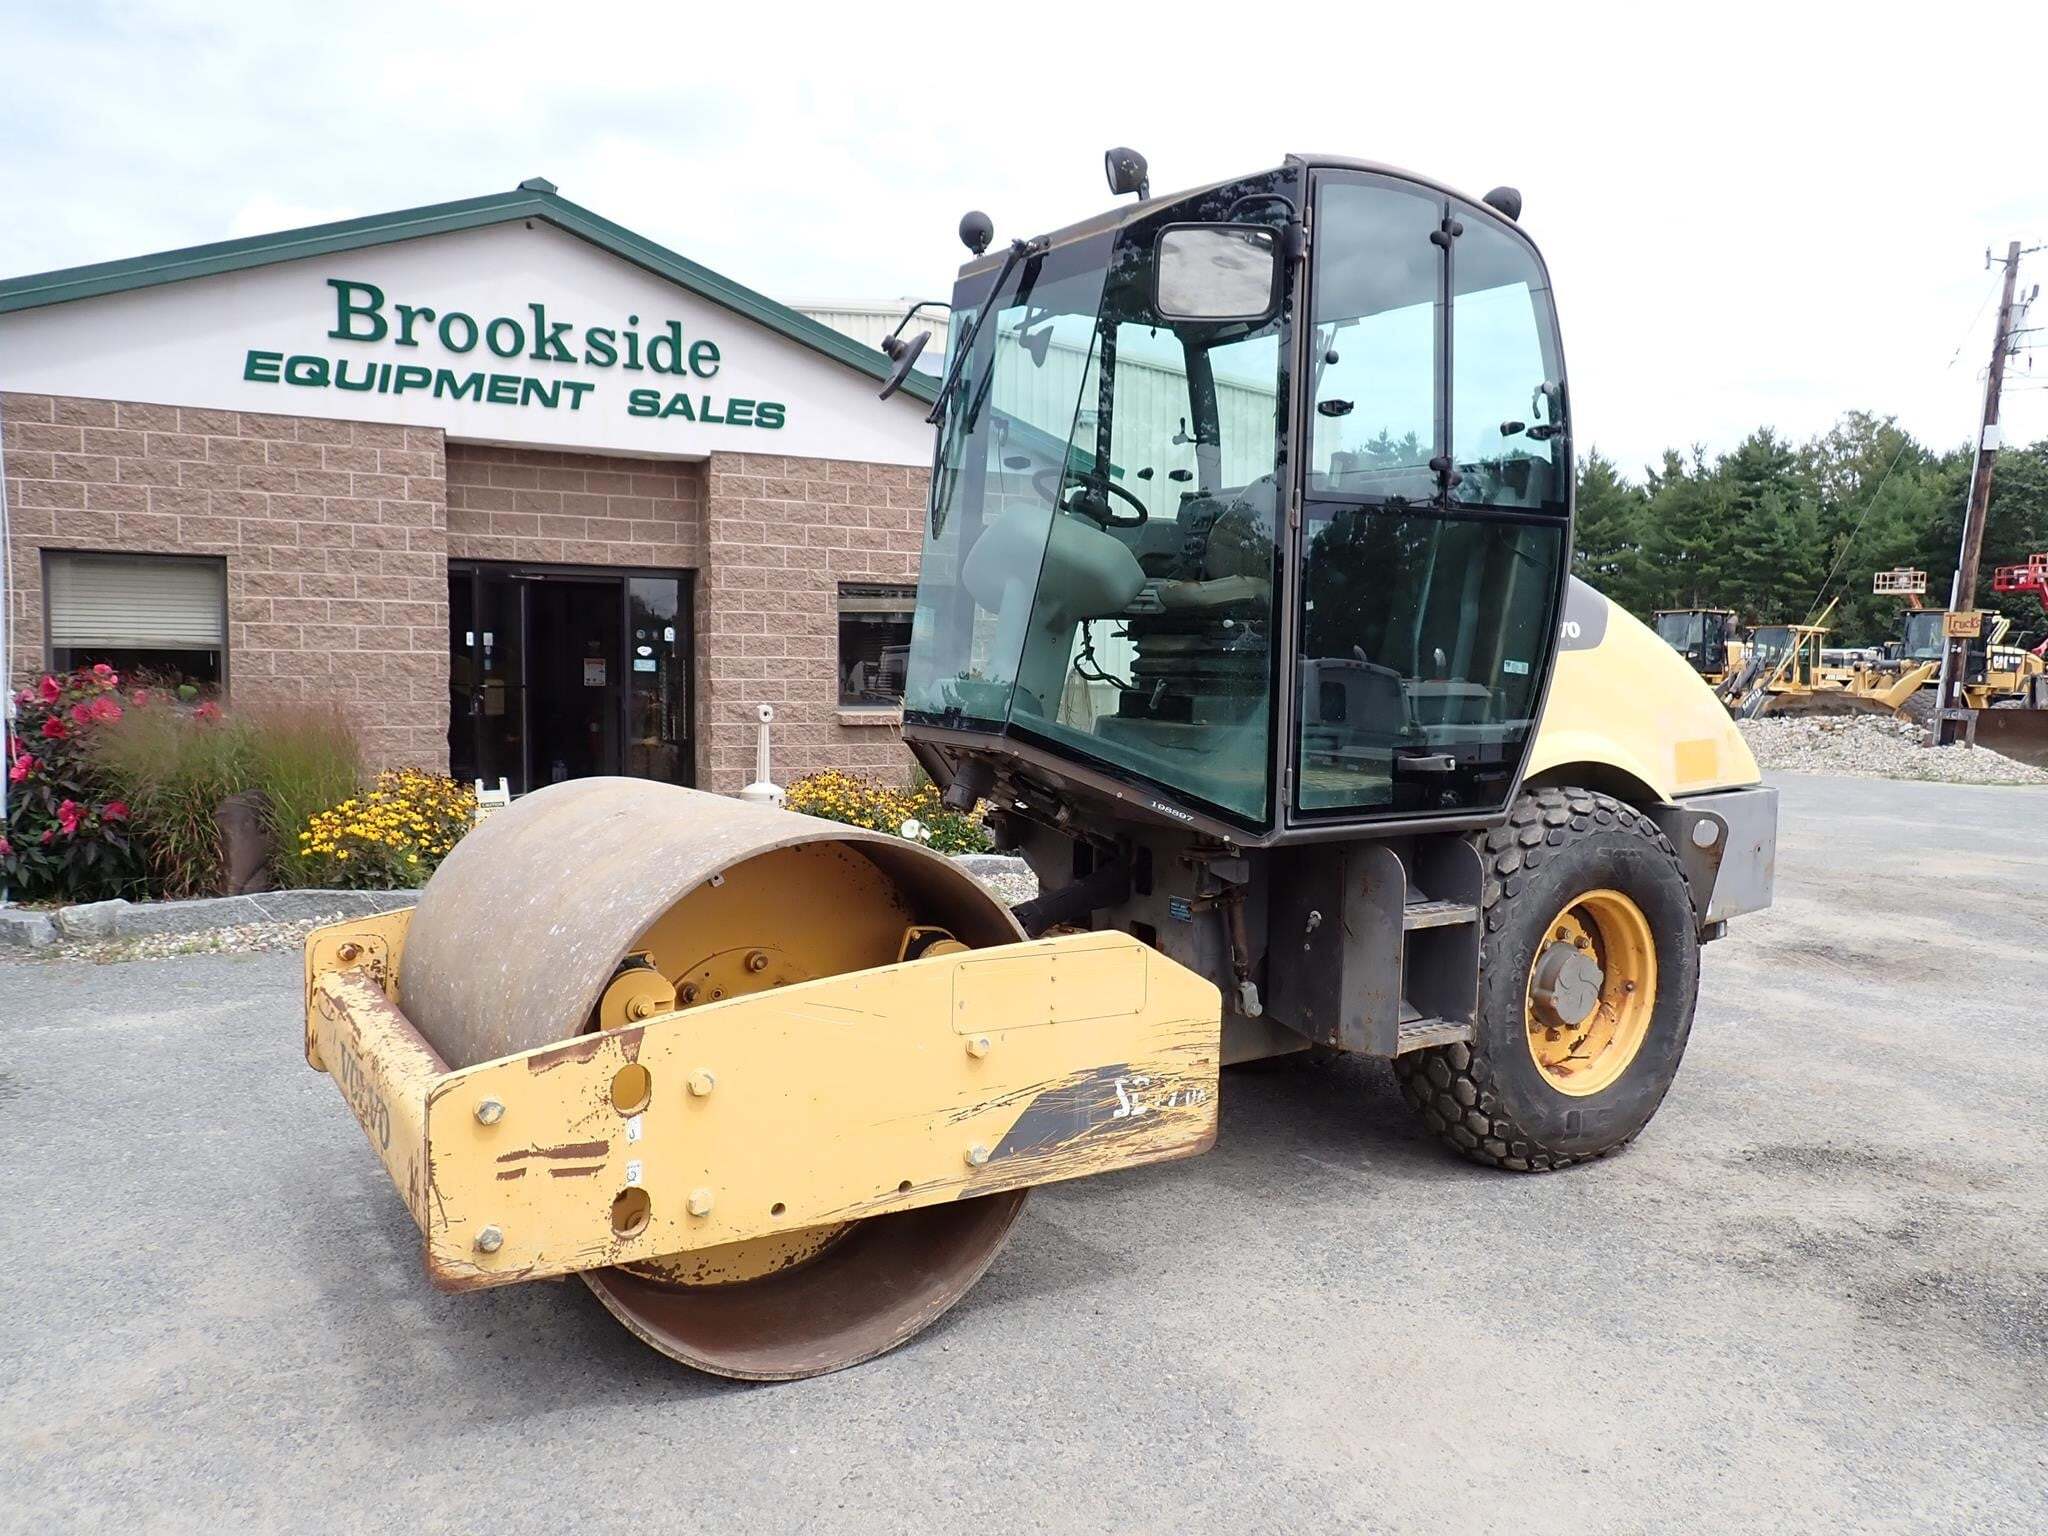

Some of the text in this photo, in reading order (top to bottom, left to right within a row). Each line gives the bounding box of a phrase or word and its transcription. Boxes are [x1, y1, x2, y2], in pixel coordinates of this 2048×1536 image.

[326, 278, 721, 379] Brookside
[243, 350, 786, 430] EQUIPMENT SALES
